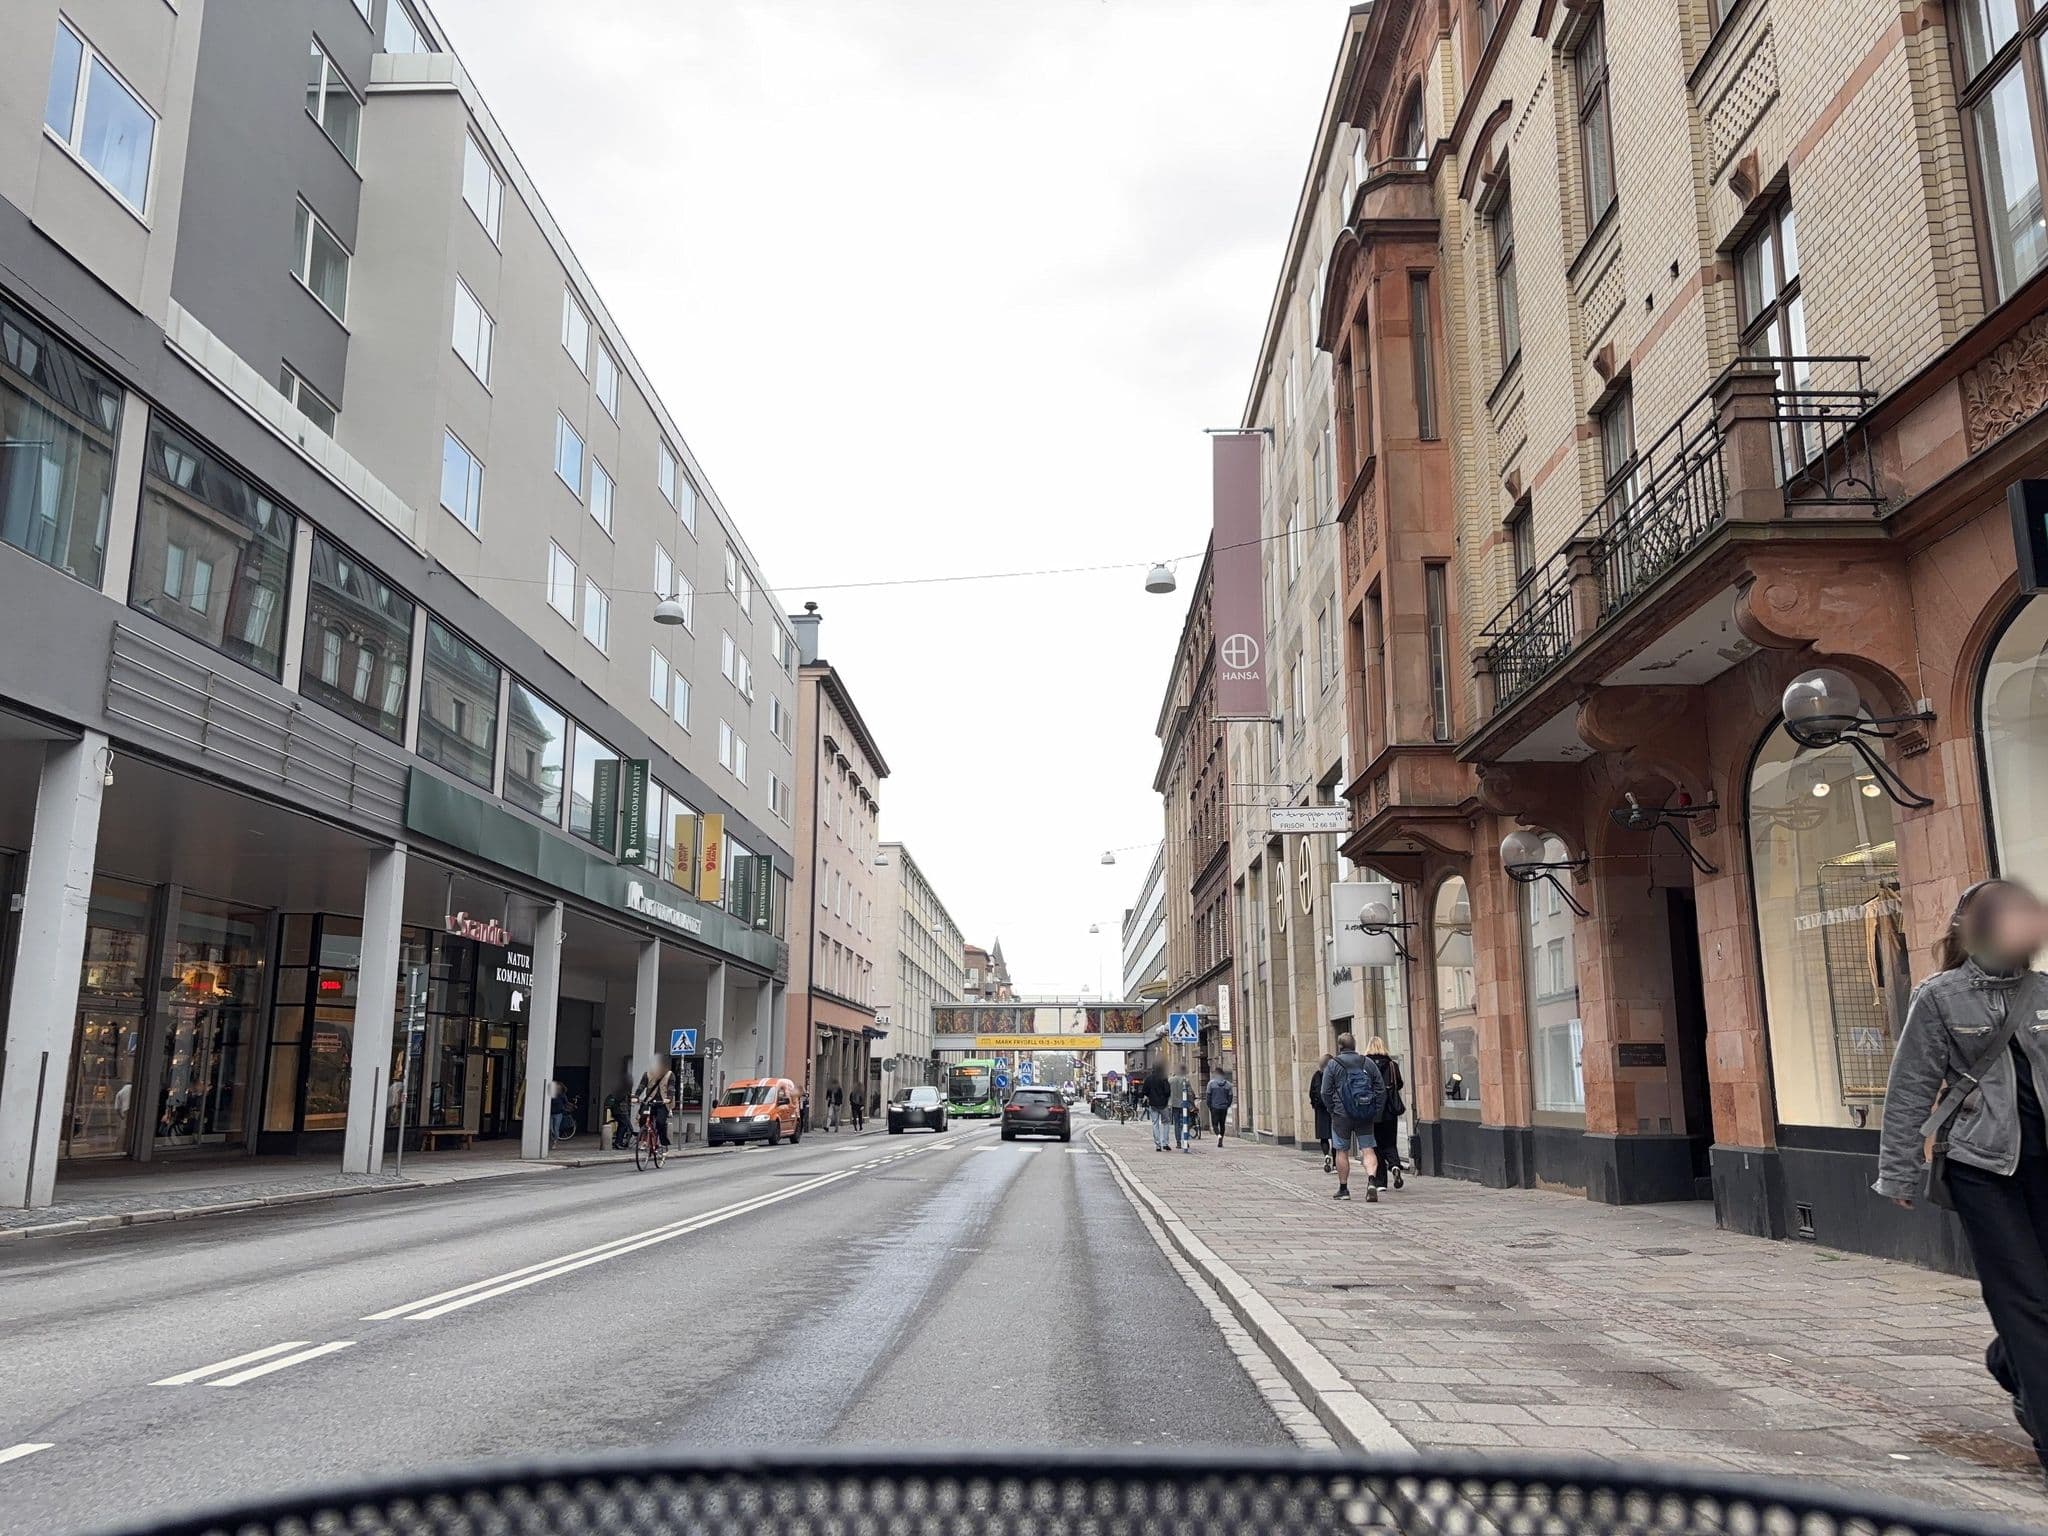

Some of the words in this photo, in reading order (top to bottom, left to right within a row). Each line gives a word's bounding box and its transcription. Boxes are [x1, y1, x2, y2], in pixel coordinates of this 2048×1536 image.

[1222, 671, 1260, 680] HANSA
[629, 764, 641, 845] NATURKOMPANIET
[507, 951, 530, 968] NATUR
[496, 967, 533, 987] KOMPANIE
